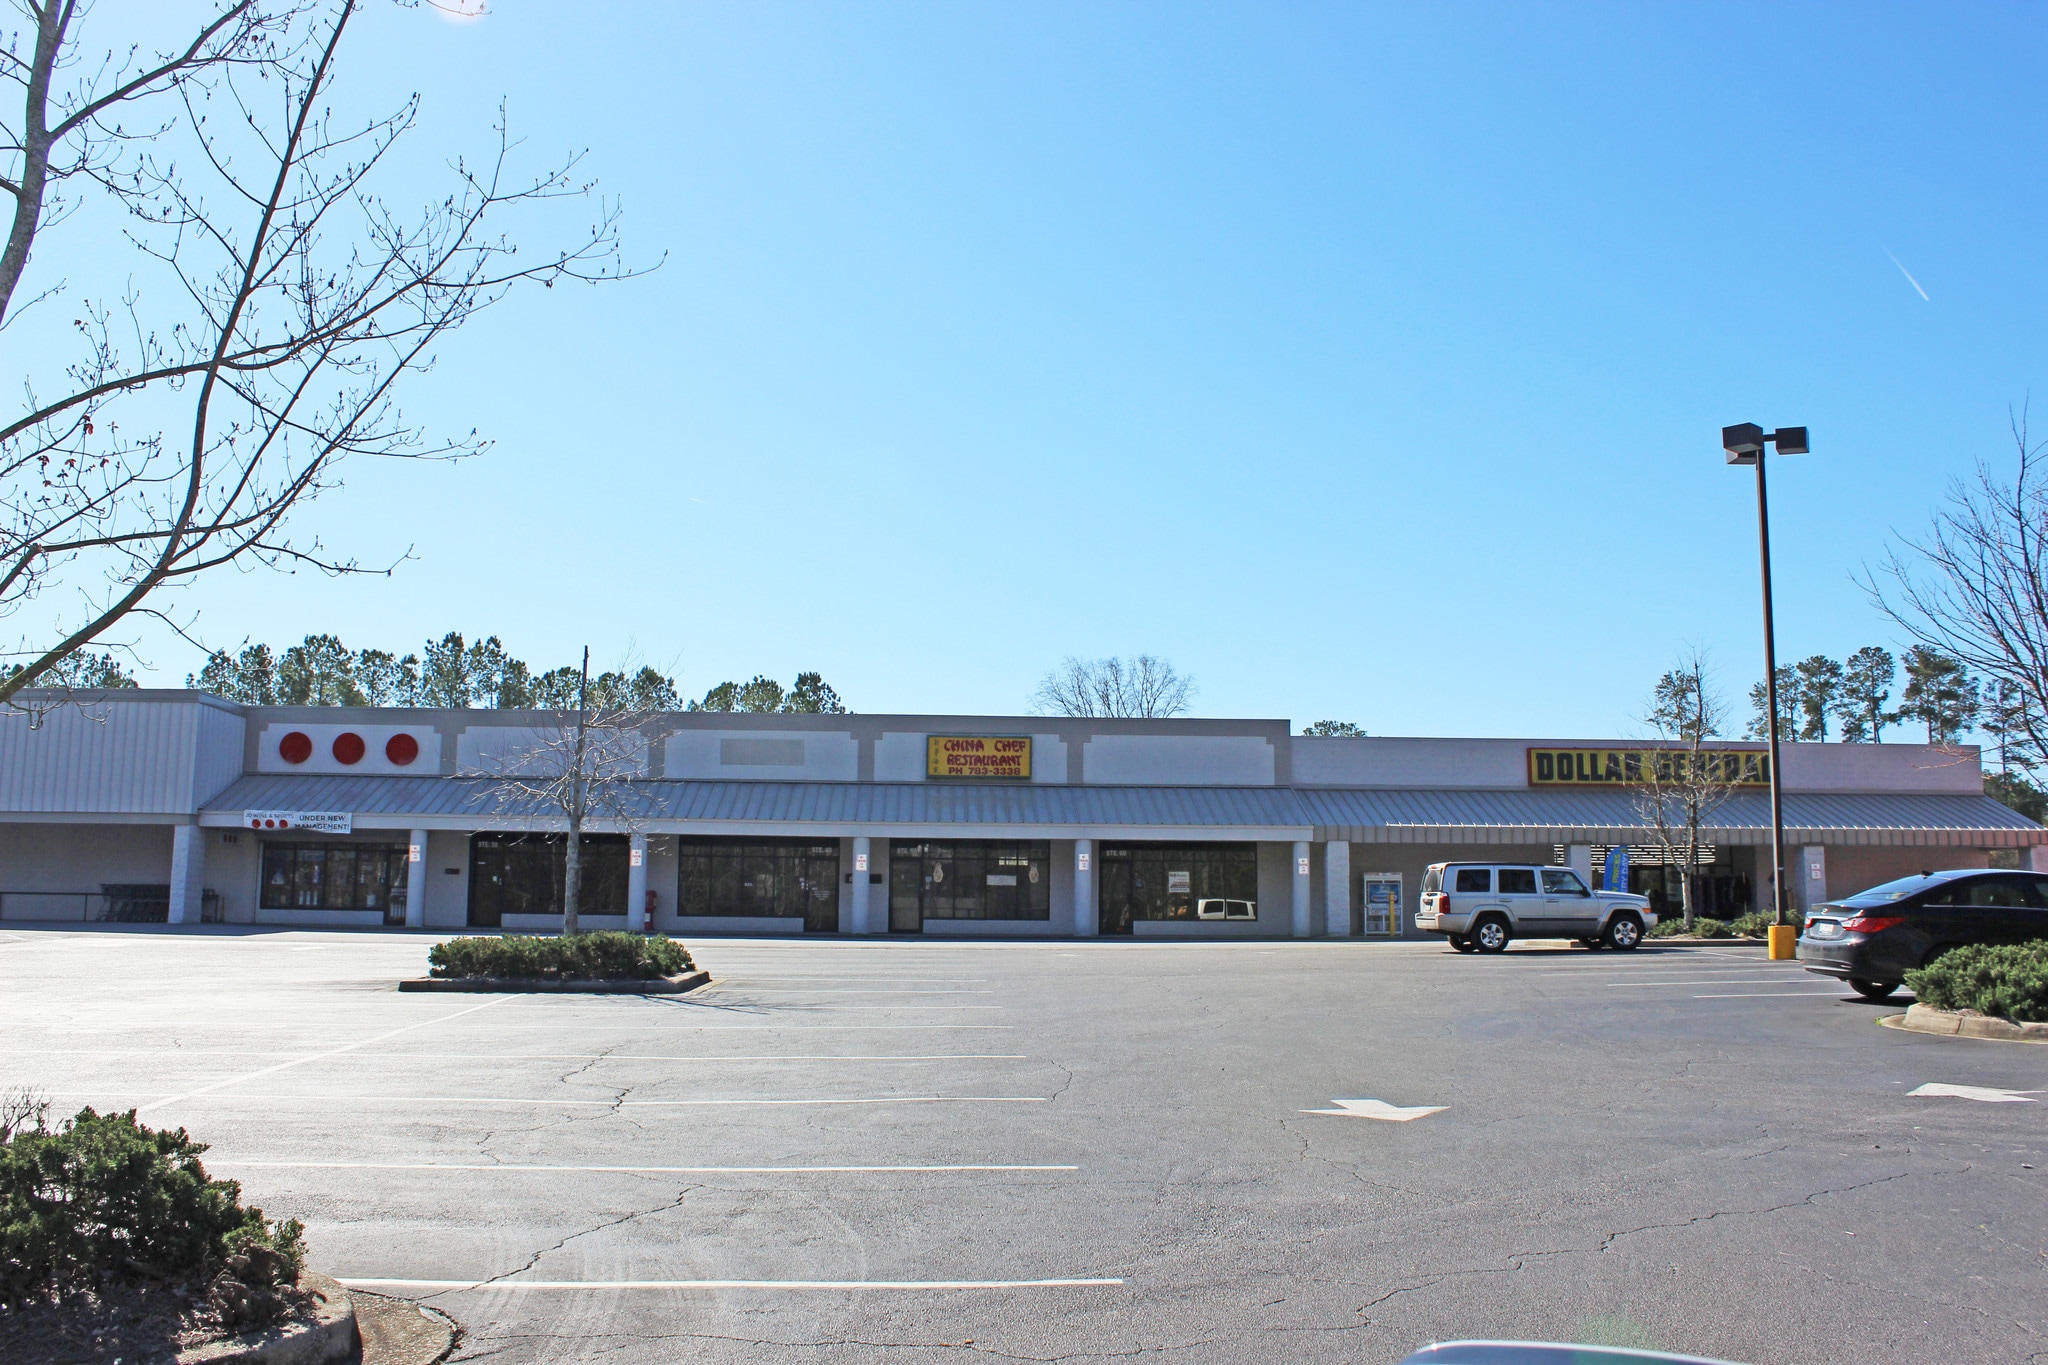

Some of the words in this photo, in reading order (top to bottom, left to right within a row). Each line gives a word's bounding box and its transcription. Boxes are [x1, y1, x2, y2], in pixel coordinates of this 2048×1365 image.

[944, 739, 984, 752] CHINA
[994, 740, 1026, 752] CHEF
[947, 754, 1022, 767] RESTAURANT
[1536, 752, 1645, 782] DOLLAR
[949, 767, 963, 775] PH
[968, 767, 1021, 776] 783-3338
